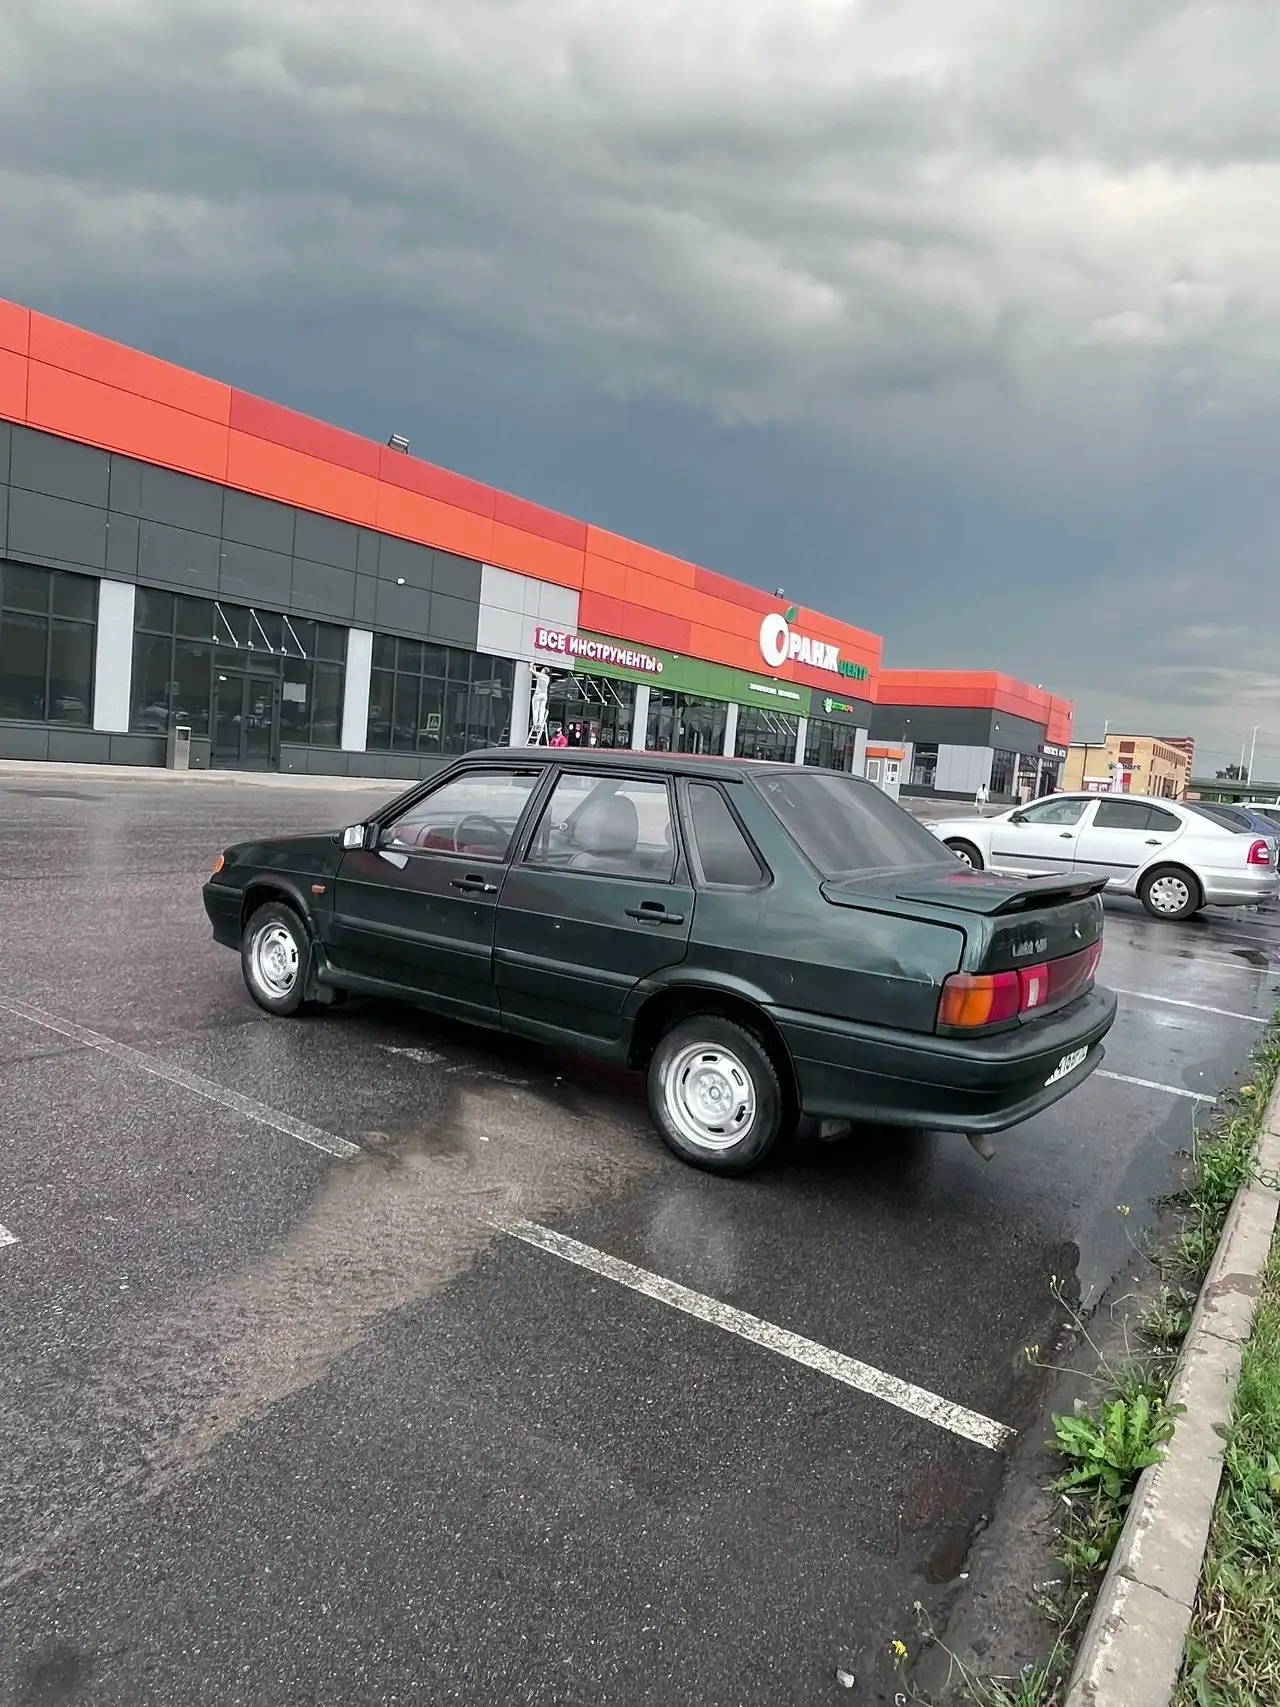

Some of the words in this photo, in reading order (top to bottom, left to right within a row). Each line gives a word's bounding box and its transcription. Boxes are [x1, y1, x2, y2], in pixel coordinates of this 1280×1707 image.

[538, 629, 566, 650] ВСЕ
[569, 636, 657, 672] ИНСТРУМЕНТЫ
[760, 613, 840, 672] ОРАНЖ
